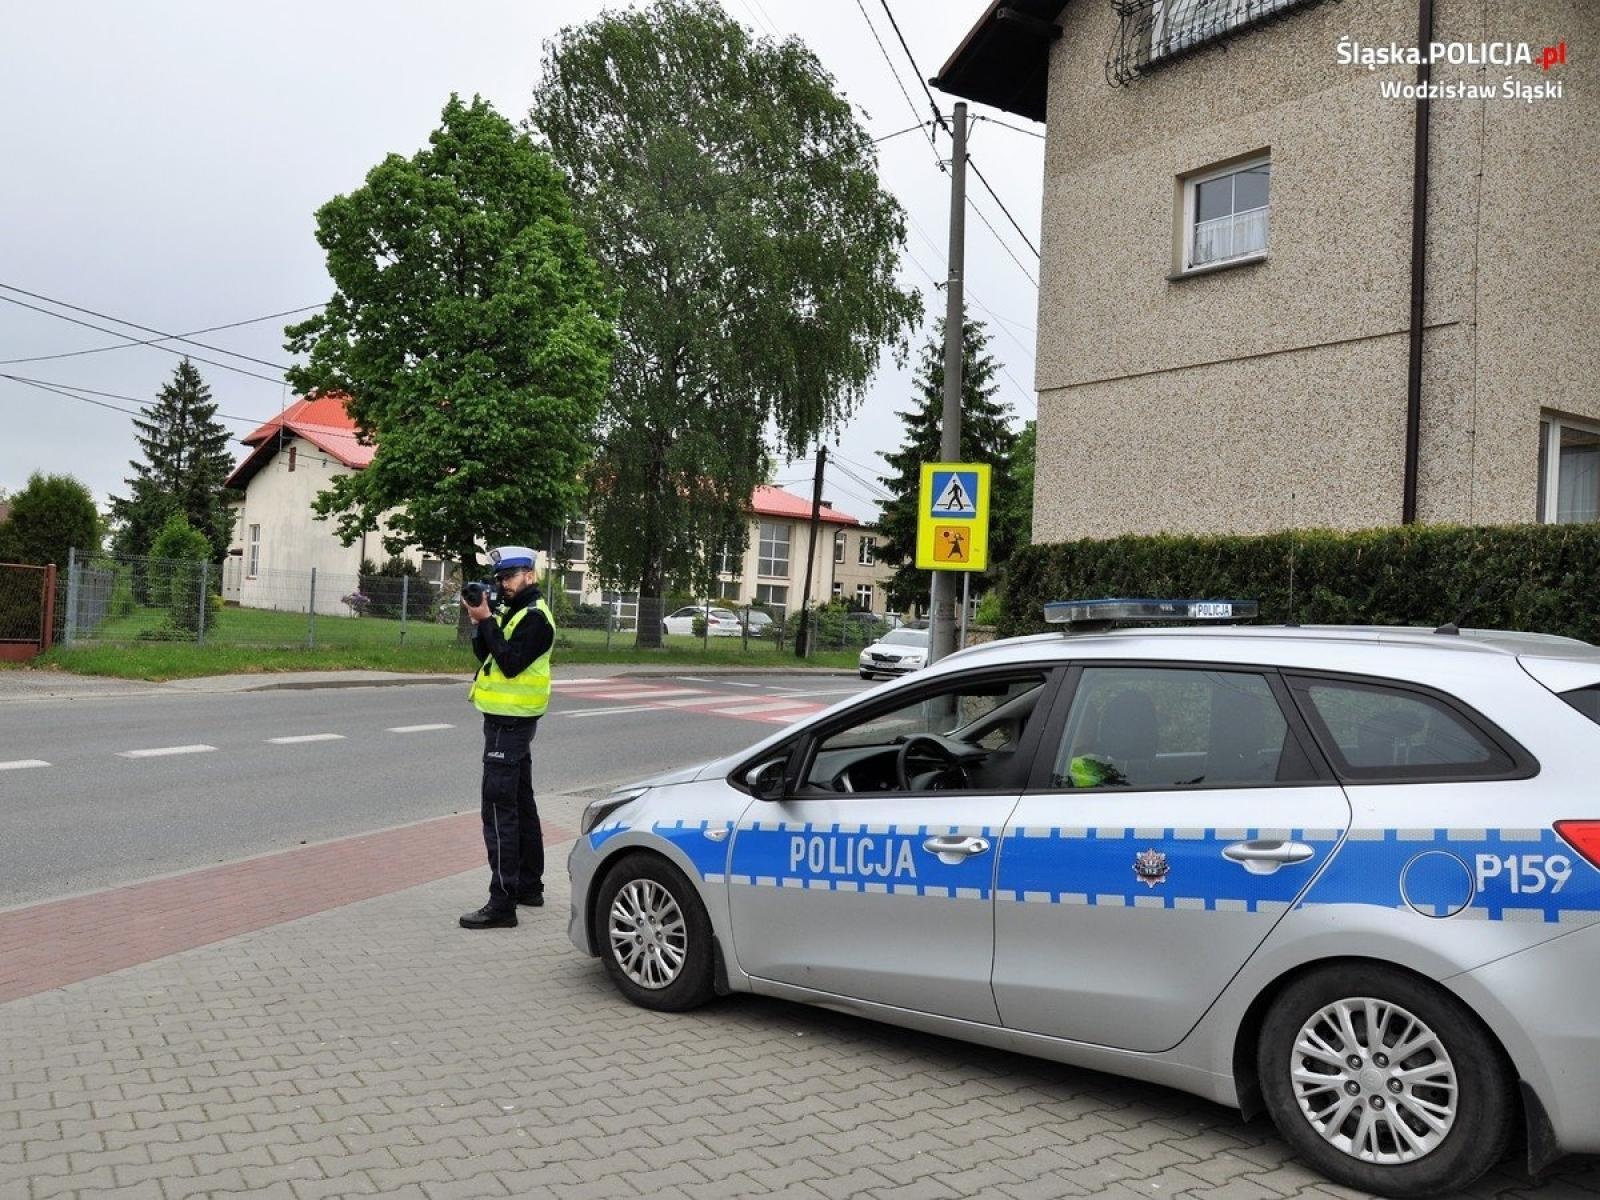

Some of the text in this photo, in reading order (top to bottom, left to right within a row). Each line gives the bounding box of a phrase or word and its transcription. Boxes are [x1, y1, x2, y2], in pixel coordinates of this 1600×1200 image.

[1198, 604, 1231, 617] POLICJA
[790, 836, 917, 878] POLICJA
[1475, 854, 1573, 894] P159
